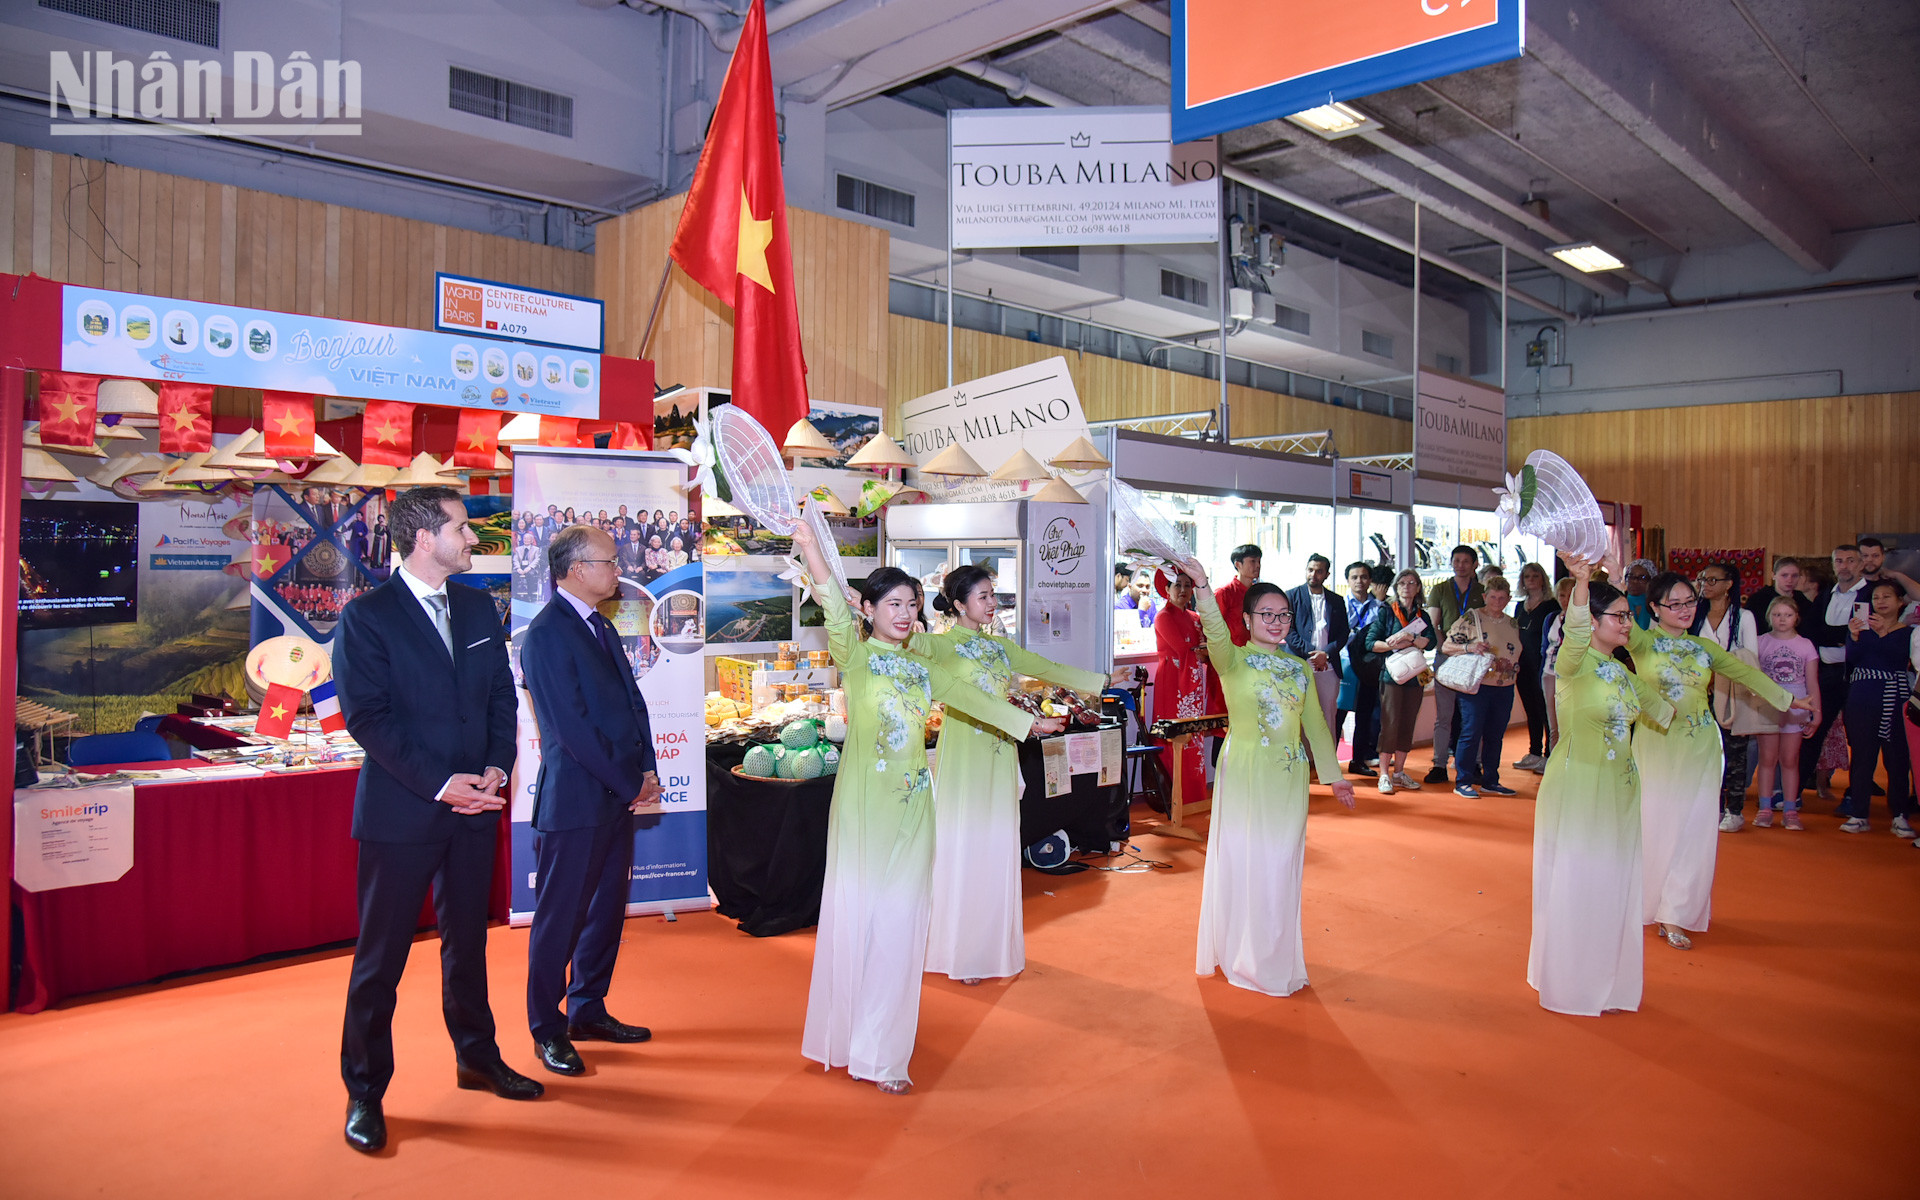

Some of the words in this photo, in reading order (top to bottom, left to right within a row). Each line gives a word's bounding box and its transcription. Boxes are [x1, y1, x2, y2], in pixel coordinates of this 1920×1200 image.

[953, 162, 1069, 187] TOUBA
[1076, 160, 1217, 185] MILANO
[956, 204, 973, 213] VIA
[977, 204, 1004, 213] LUIGI
[1124, 200, 1166, 210] MILANO
[1190, 199, 1217, 209] ITALY
[1066, 225, 1079, 234] 02
[1081, 224, 1104, 234] 6698
[1107, 223, 1131, 233] 4618
[445, 286, 483, 301] WORLD
[445, 297, 458, 309] IN
[486, 289, 526, 303] CENTRE
[527, 296, 575, 312] CULTUREL
[486, 299, 501, 309] DU
[504, 301, 548, 317] VIETNAM
[445, 310, 475, 323] PARIS
[500, 323, 527, 335] A079
[284, 329, 398, 370] Bonjour
[163, 371, 186, 379] CCV
[350, 366, 400, 387] VIỆT
[406, 374, 457, 391] NAM
[964, 398, 1070, 443] MILANO
[1418, 406, 1459, 436] TOUBA
[1460, 418, 1504, 444] MILANO
[172, 537, 199, 545] Pacific
[200, 538, 231, 547] Voyages
[1037, 580, 1091, 589] chovietphap.com
[656, 730, 688, 745] HOÁ
[655, 747, 680, 760] HÁP
[669, 776, 690, 787] DU
[659, 791, 688, 803] NCE
